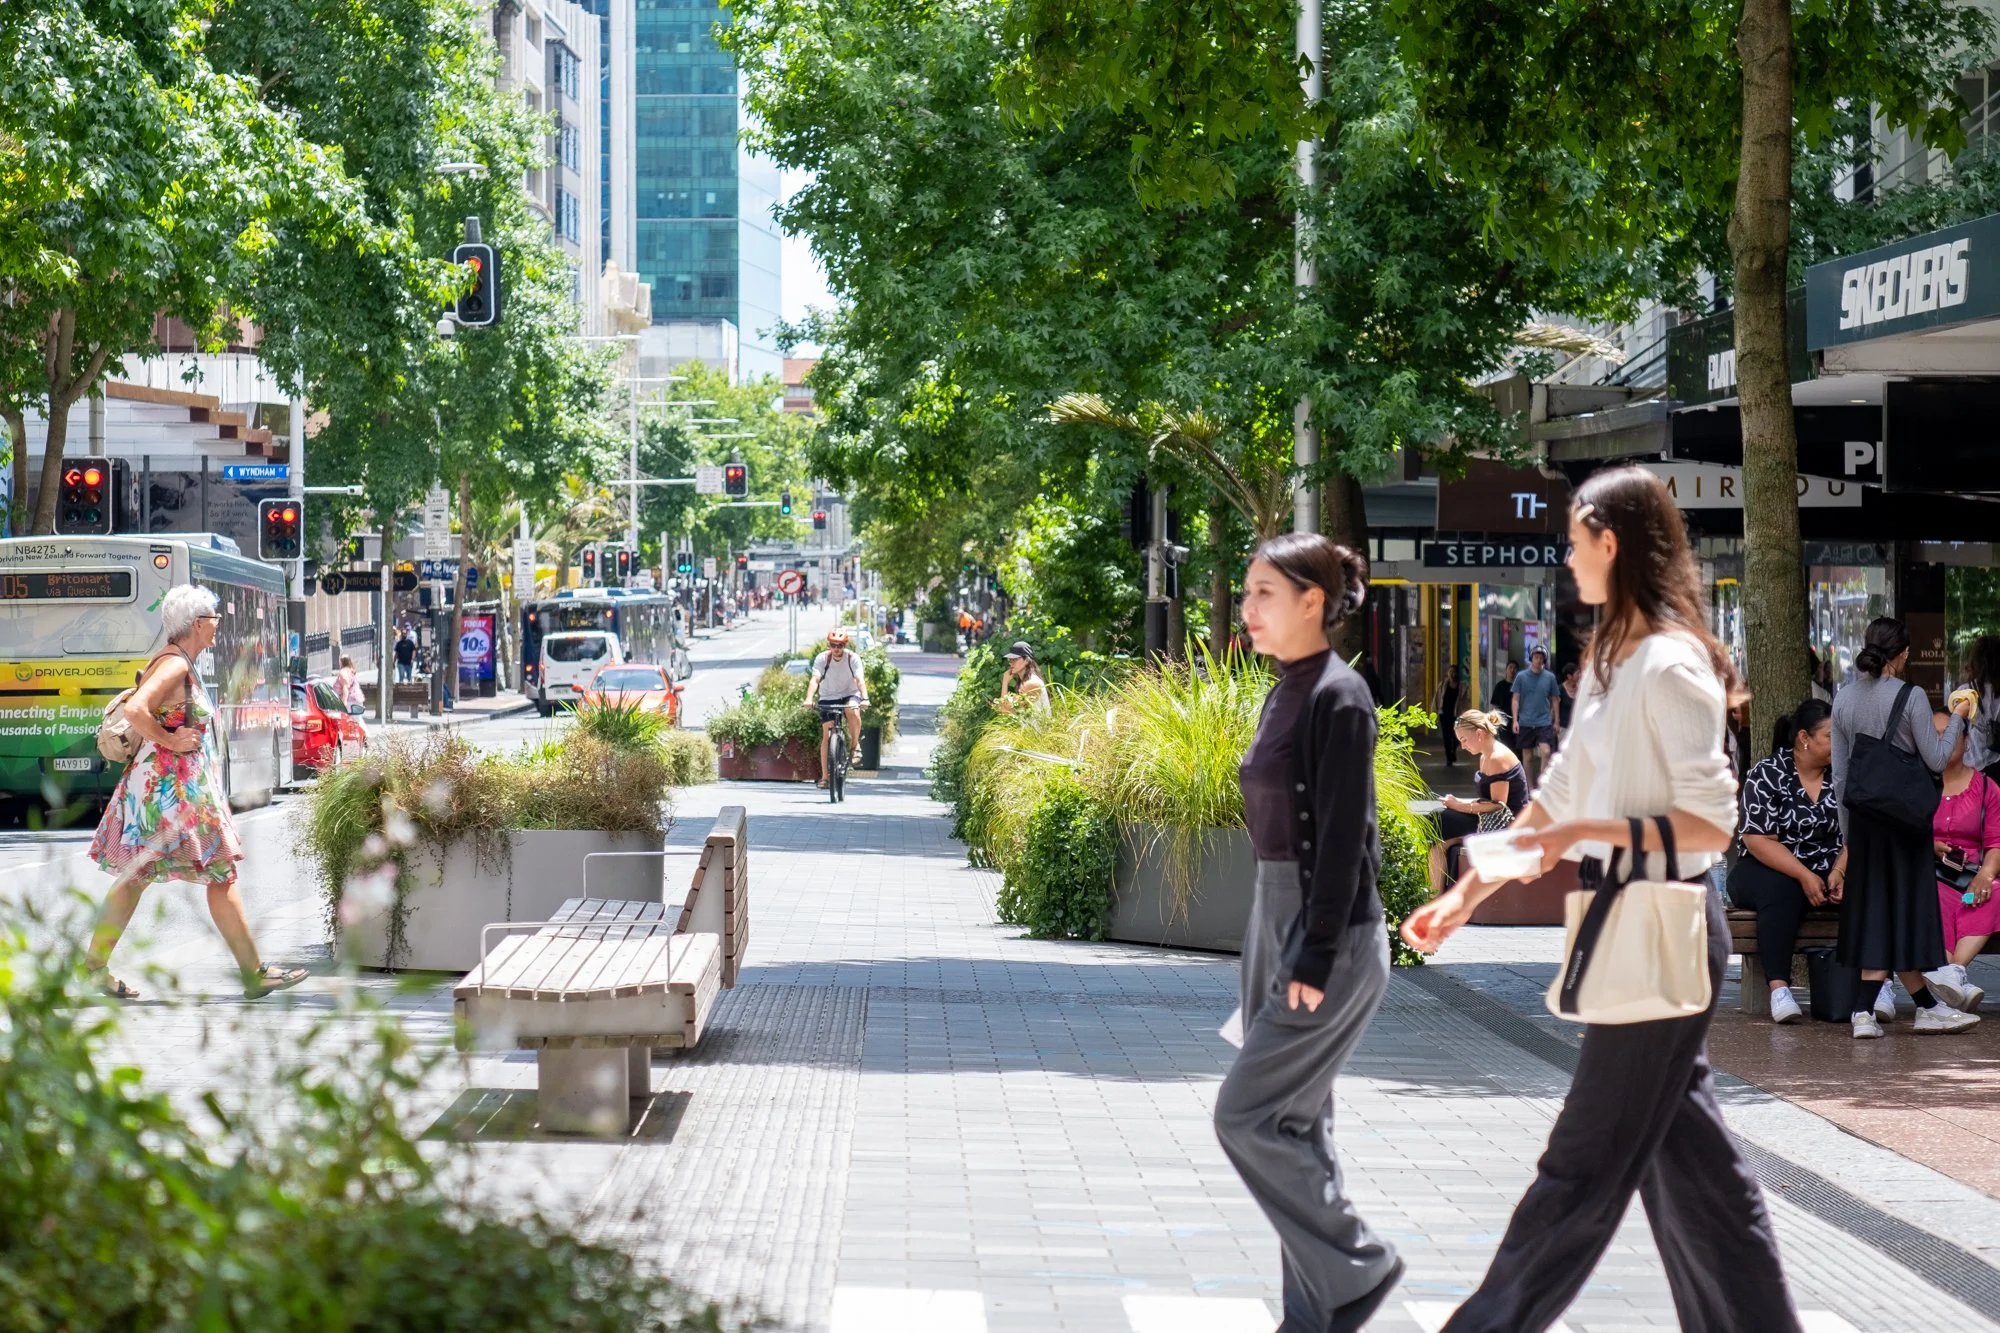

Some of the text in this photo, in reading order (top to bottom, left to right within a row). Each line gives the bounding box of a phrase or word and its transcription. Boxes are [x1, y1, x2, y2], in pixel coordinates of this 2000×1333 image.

[1840, 238, 1970, 330] SKECHERS
[239, 467, 275, 477] WYNDHAM
[15, 545, 56, 555] NB4275
[44, 552, 74, 560] Zealand
[108, 553, 142, 561] Together
[0, 575, 112, 598] 05 Britomart
[67, 585, 97, 597] Queen
[0, 723, 42, 736] usands
[44, 723, 58, 737] of
[55, 760, 90, 769] HAY919
